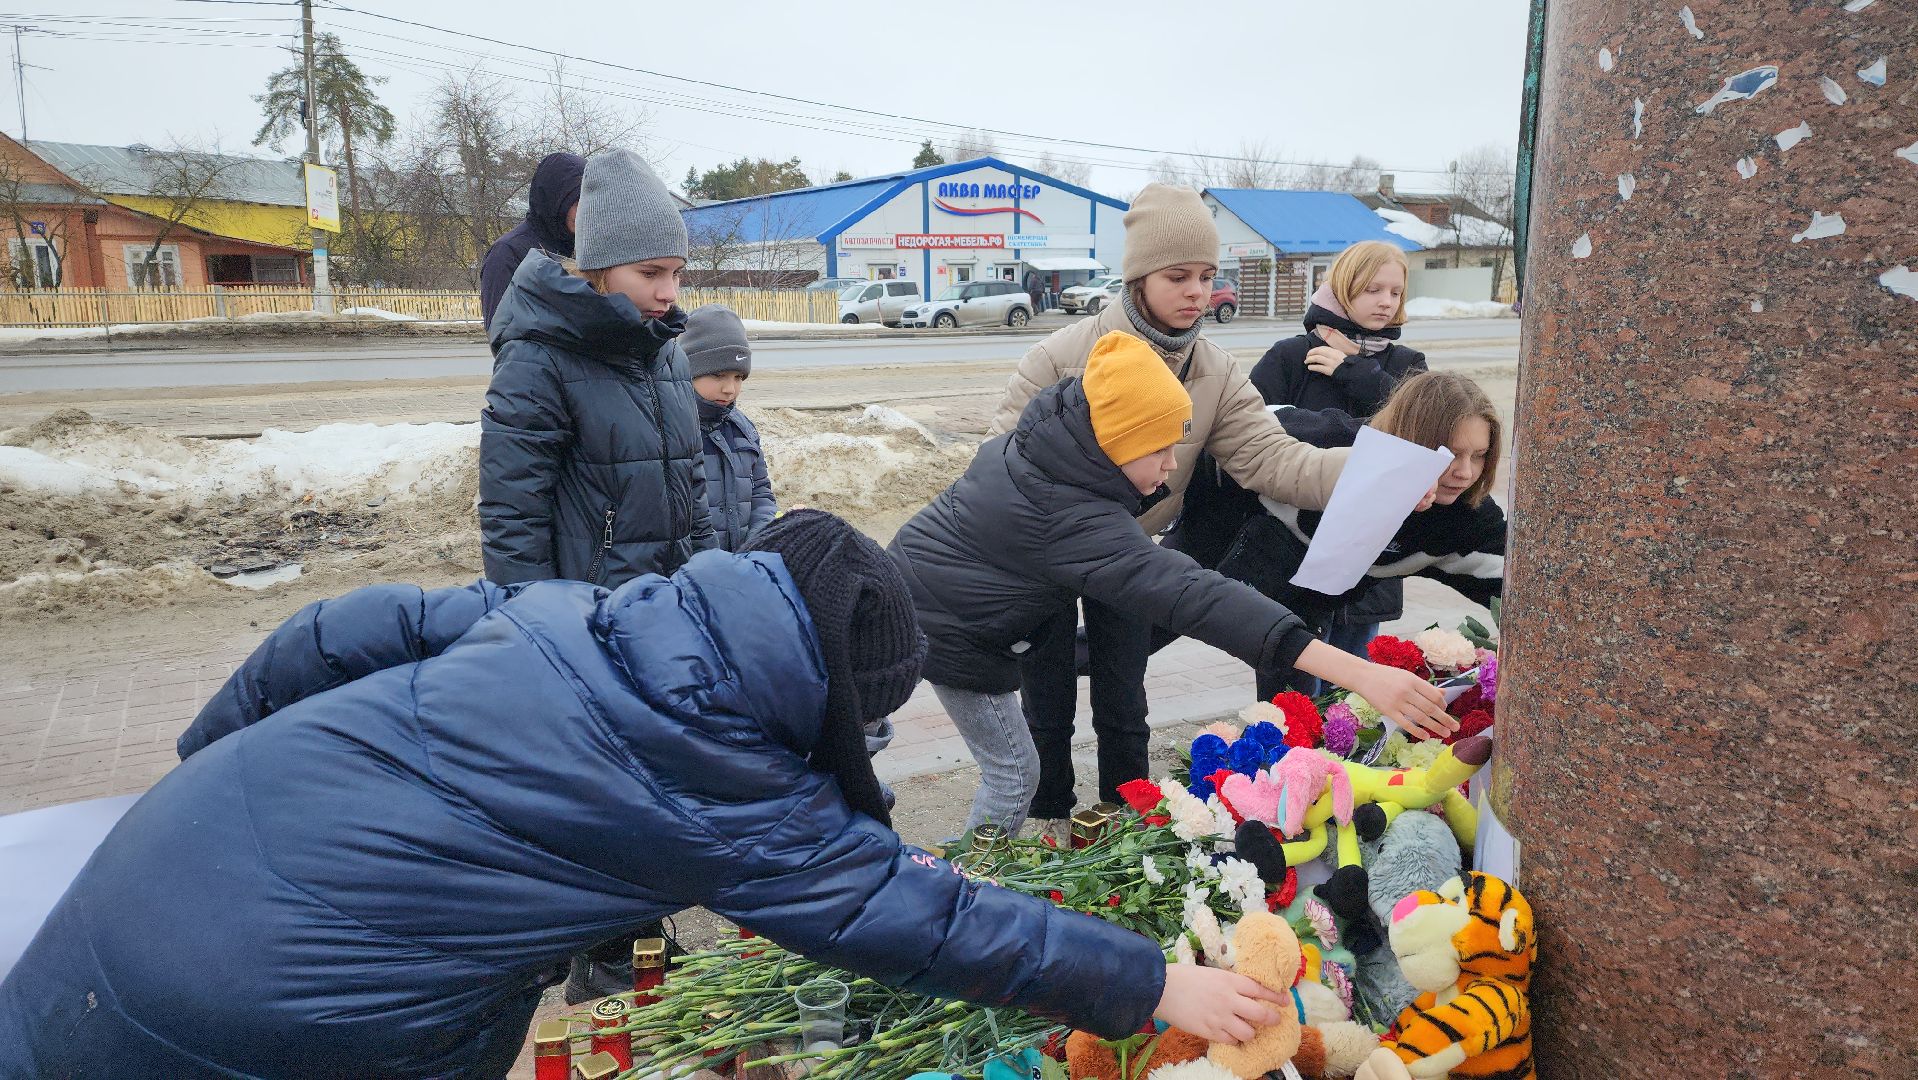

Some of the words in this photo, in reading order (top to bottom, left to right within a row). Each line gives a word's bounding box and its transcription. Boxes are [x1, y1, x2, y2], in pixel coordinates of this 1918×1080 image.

[939, 182, 980, 198] АКВА
[984, 184, 1041, 200] МАСТЕР
[898, 236, 1003, 248] НЕДОРОГАЯ-МЕБЕЛЬ.РФ
